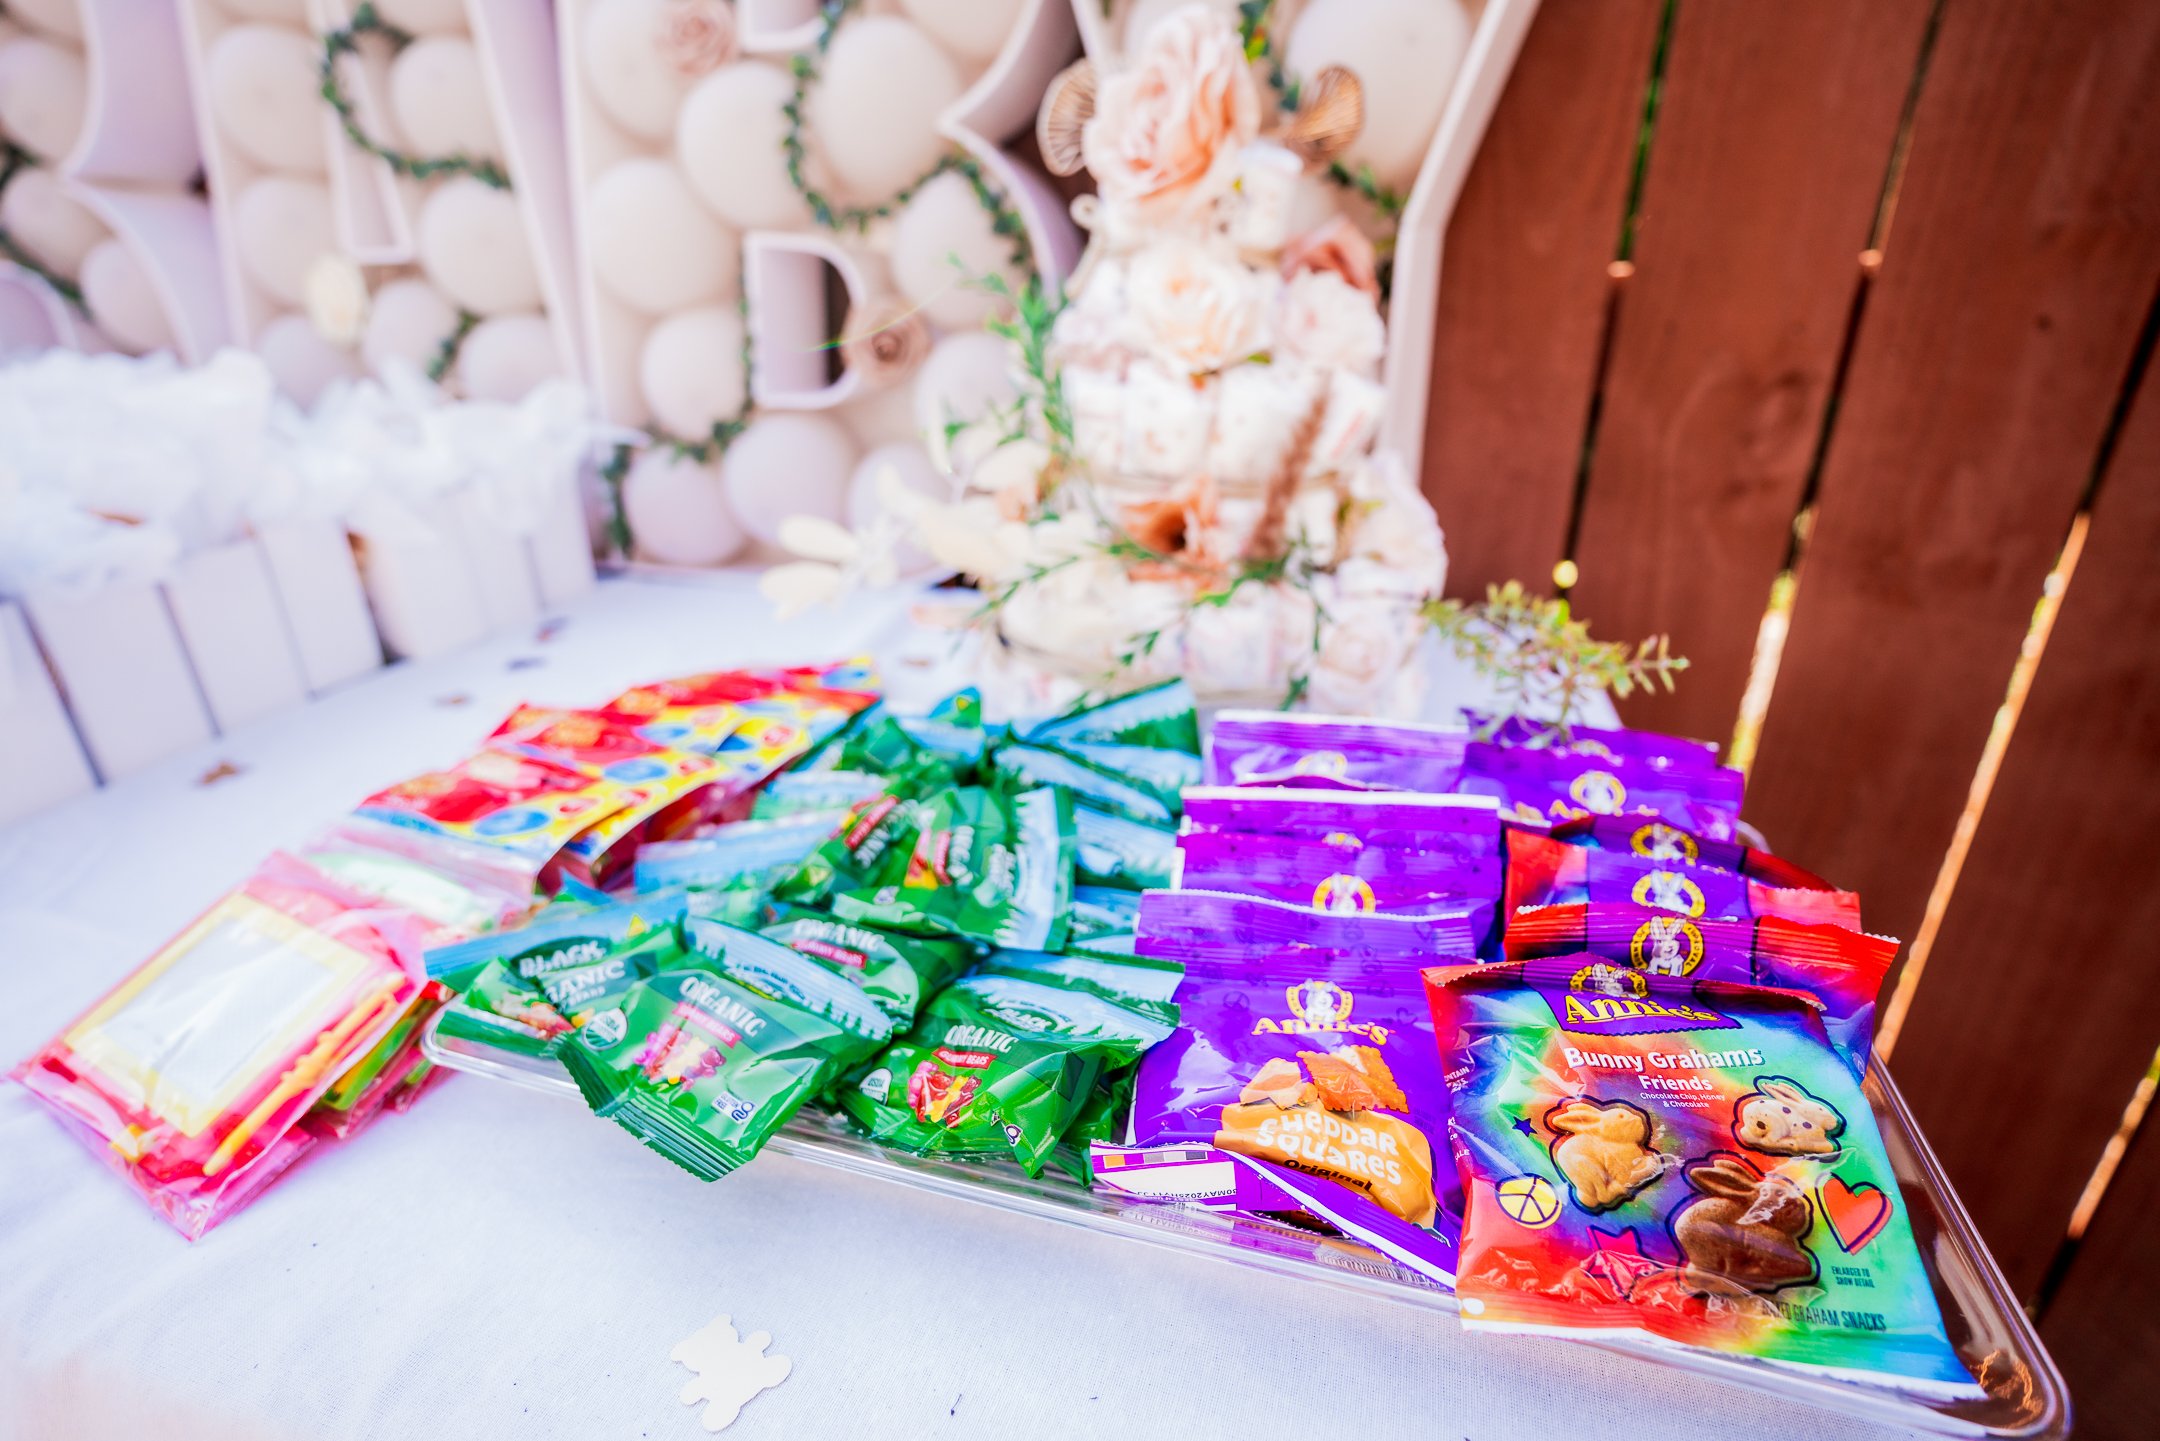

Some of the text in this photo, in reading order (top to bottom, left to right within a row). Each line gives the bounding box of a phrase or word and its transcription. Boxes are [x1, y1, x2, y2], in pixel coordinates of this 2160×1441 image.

[679, 976, 767, 1037] ORGANIC
[1565, 994, 1720, 1024] Annie's
[944, 1025, 1019, 1053] ORGANIC
[1251, 1017, 1389, 1045] Annie's
[1564, 1047, 1766, 1073] Bunny Grahams
[1638, 1075, 1713, 1091] Friends
[1640, 1092, 1725, 1103] Chocolate Chip, Honey
[1671, 1101, 1710, 1109] Chocolate
[1284, 1159, 1373, 1191] Original
[1792, 1304, 1840, 1327] GRAHAM
[1840, 1310, 1887, 1331] SNACKS
